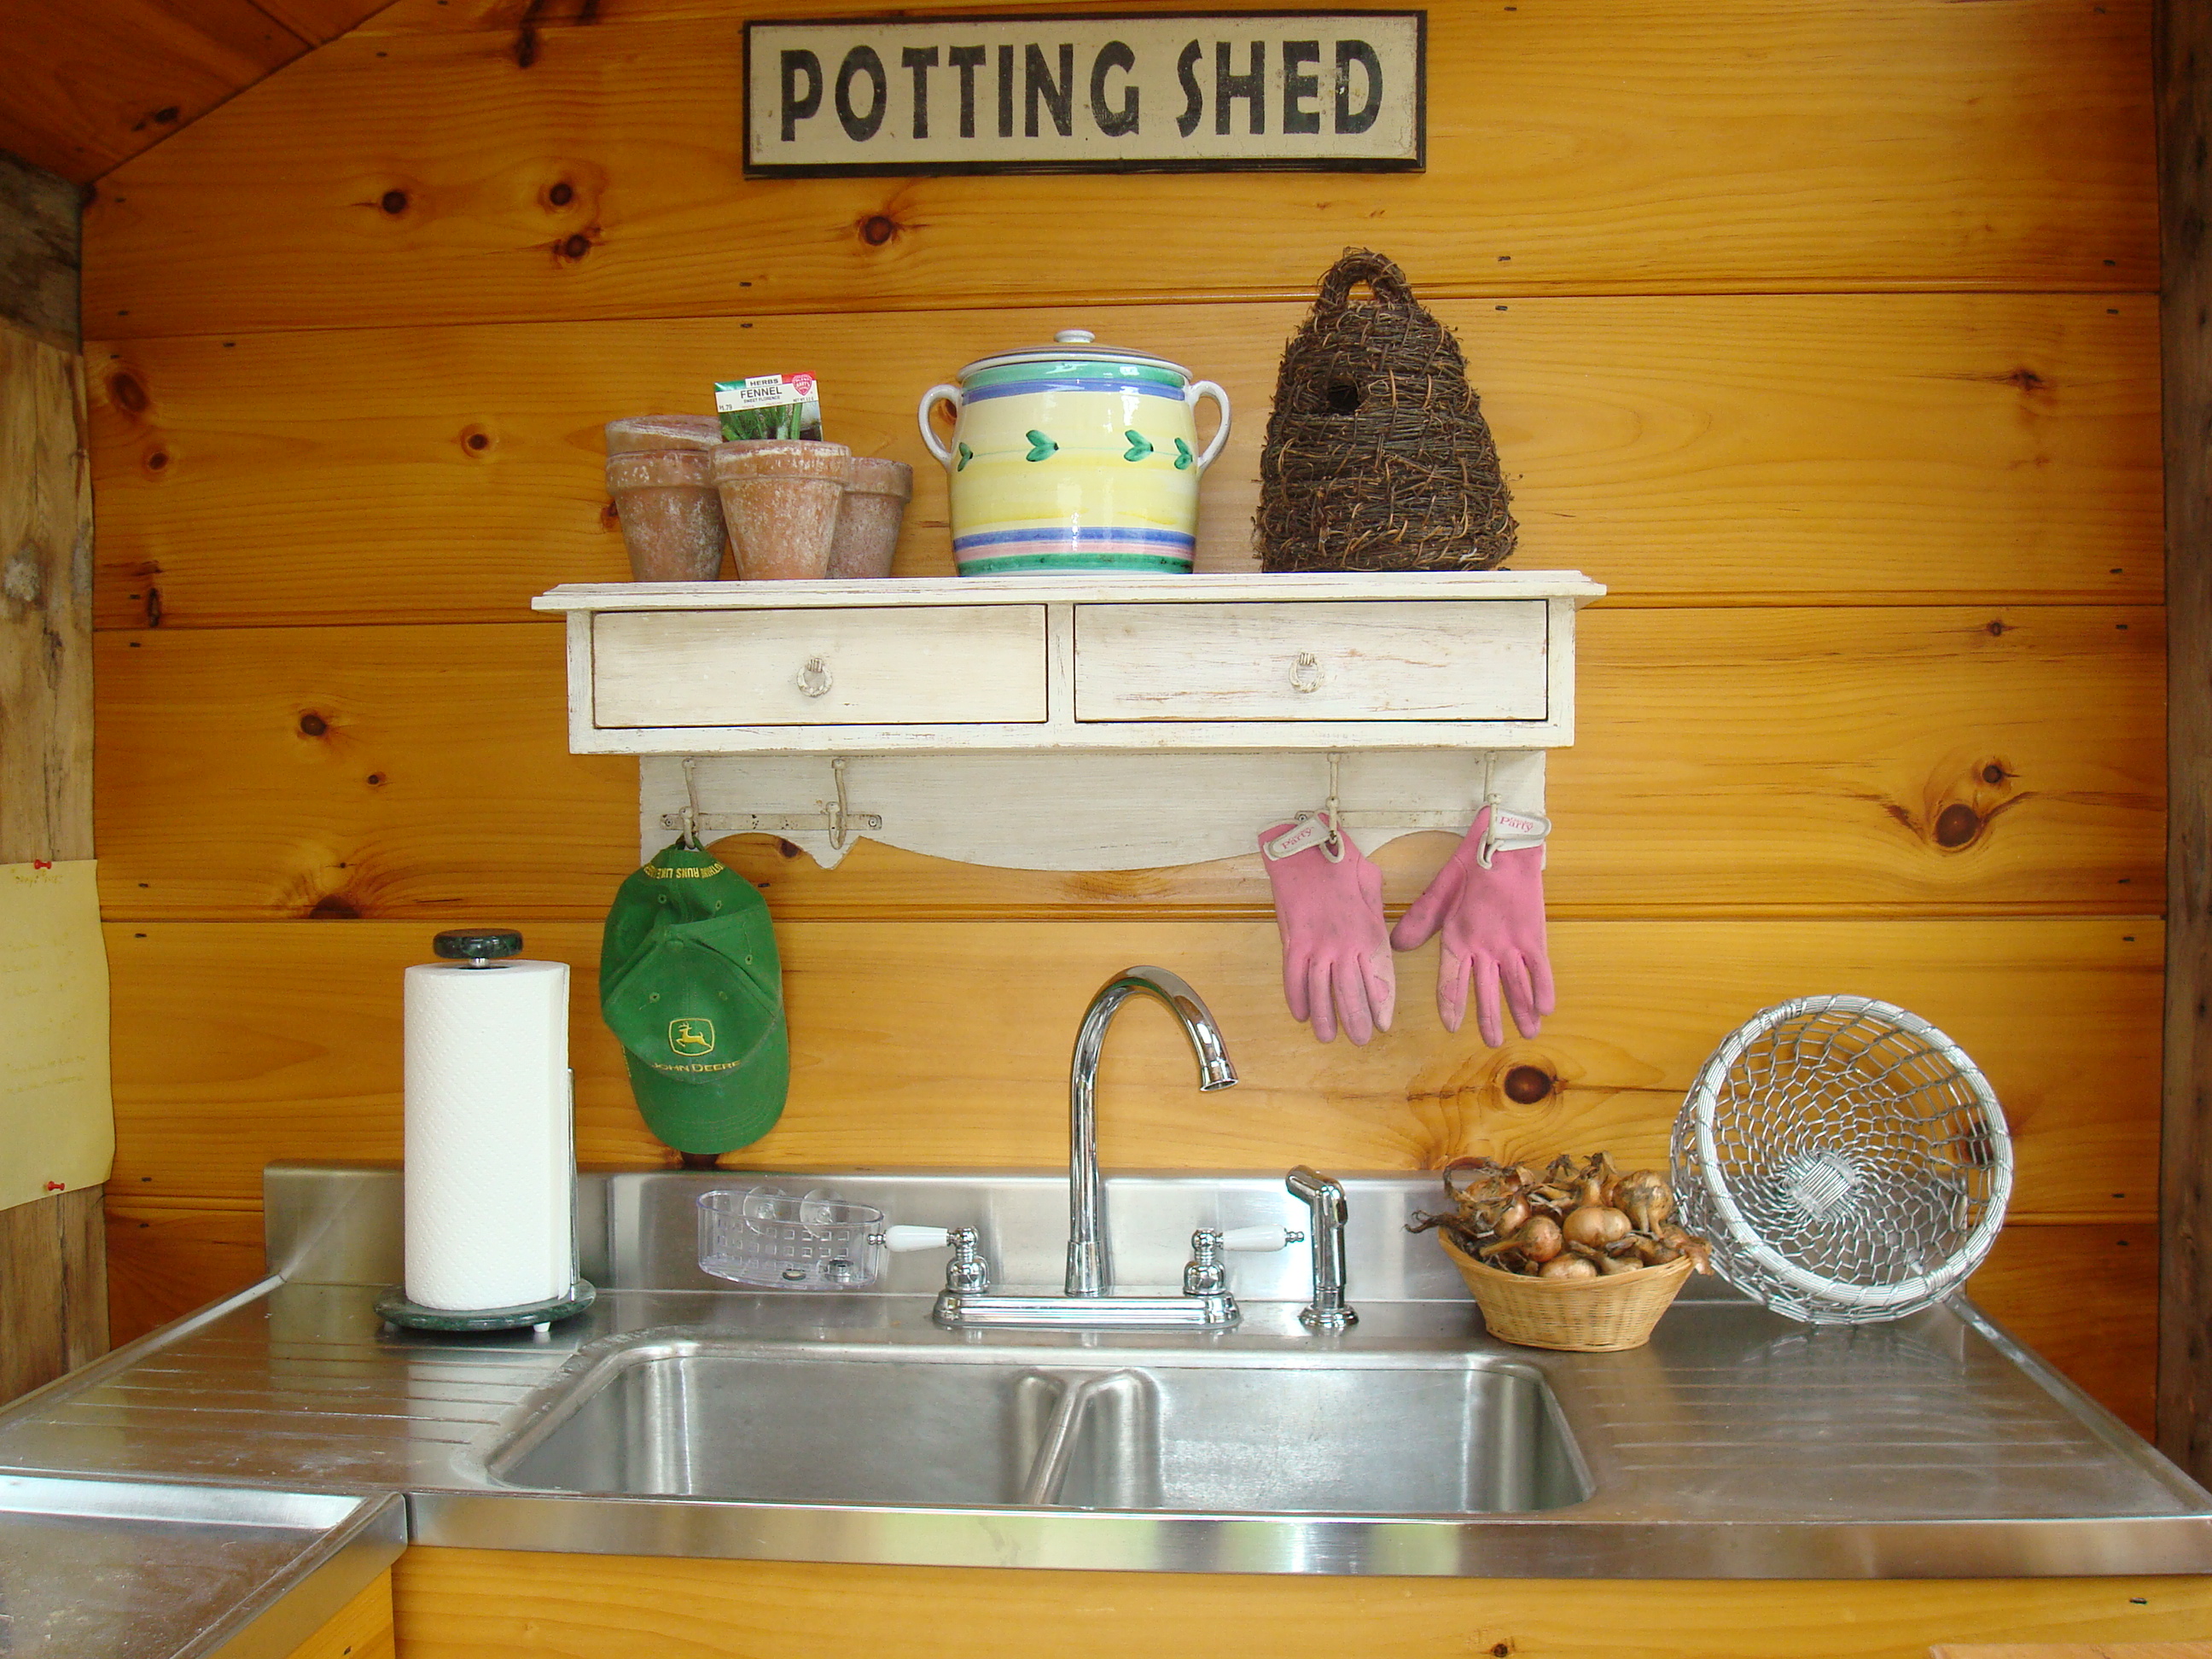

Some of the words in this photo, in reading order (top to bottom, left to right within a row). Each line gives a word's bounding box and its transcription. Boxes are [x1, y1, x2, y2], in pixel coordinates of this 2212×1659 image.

[780, 39, 1139, 143] POTTING
[1175, 38, 1383, 138] SHED
[749, 378, 779, 387] HERBS
[740, 386, 783, 399] FENNEL
[1499, 816, 1534, 833] Party
[1282, 827, 1313, 849] Party
[656, 867, 673, 879] LIKE
[676, 867, 700, 878] RUNS
[700, 861, 725, 879] OTHING
[651, 1062, 690, 1072] JOHN
[691, 1059, 741, 1072] DEERE
